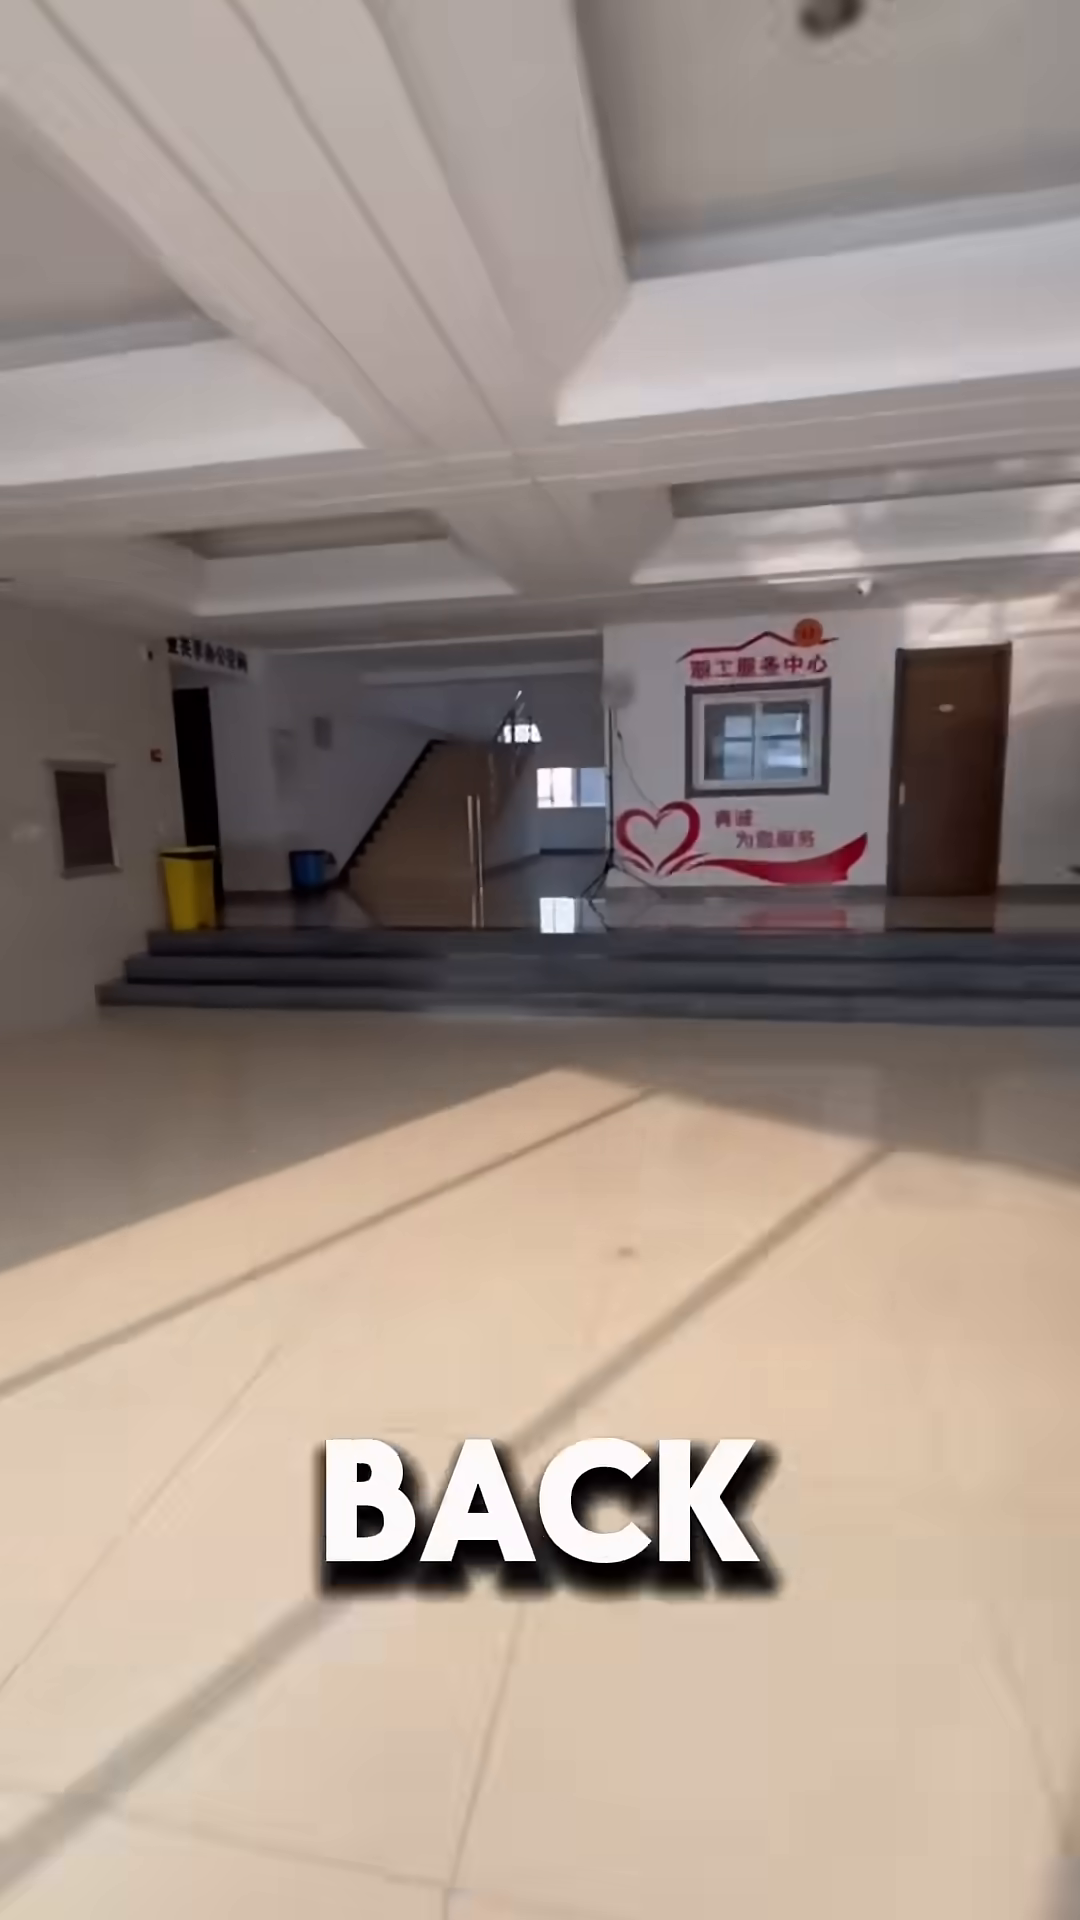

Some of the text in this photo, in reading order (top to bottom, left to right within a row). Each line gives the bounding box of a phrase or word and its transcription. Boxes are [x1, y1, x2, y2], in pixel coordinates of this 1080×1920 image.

[690, 654, 828, 679] 职工服务中心
